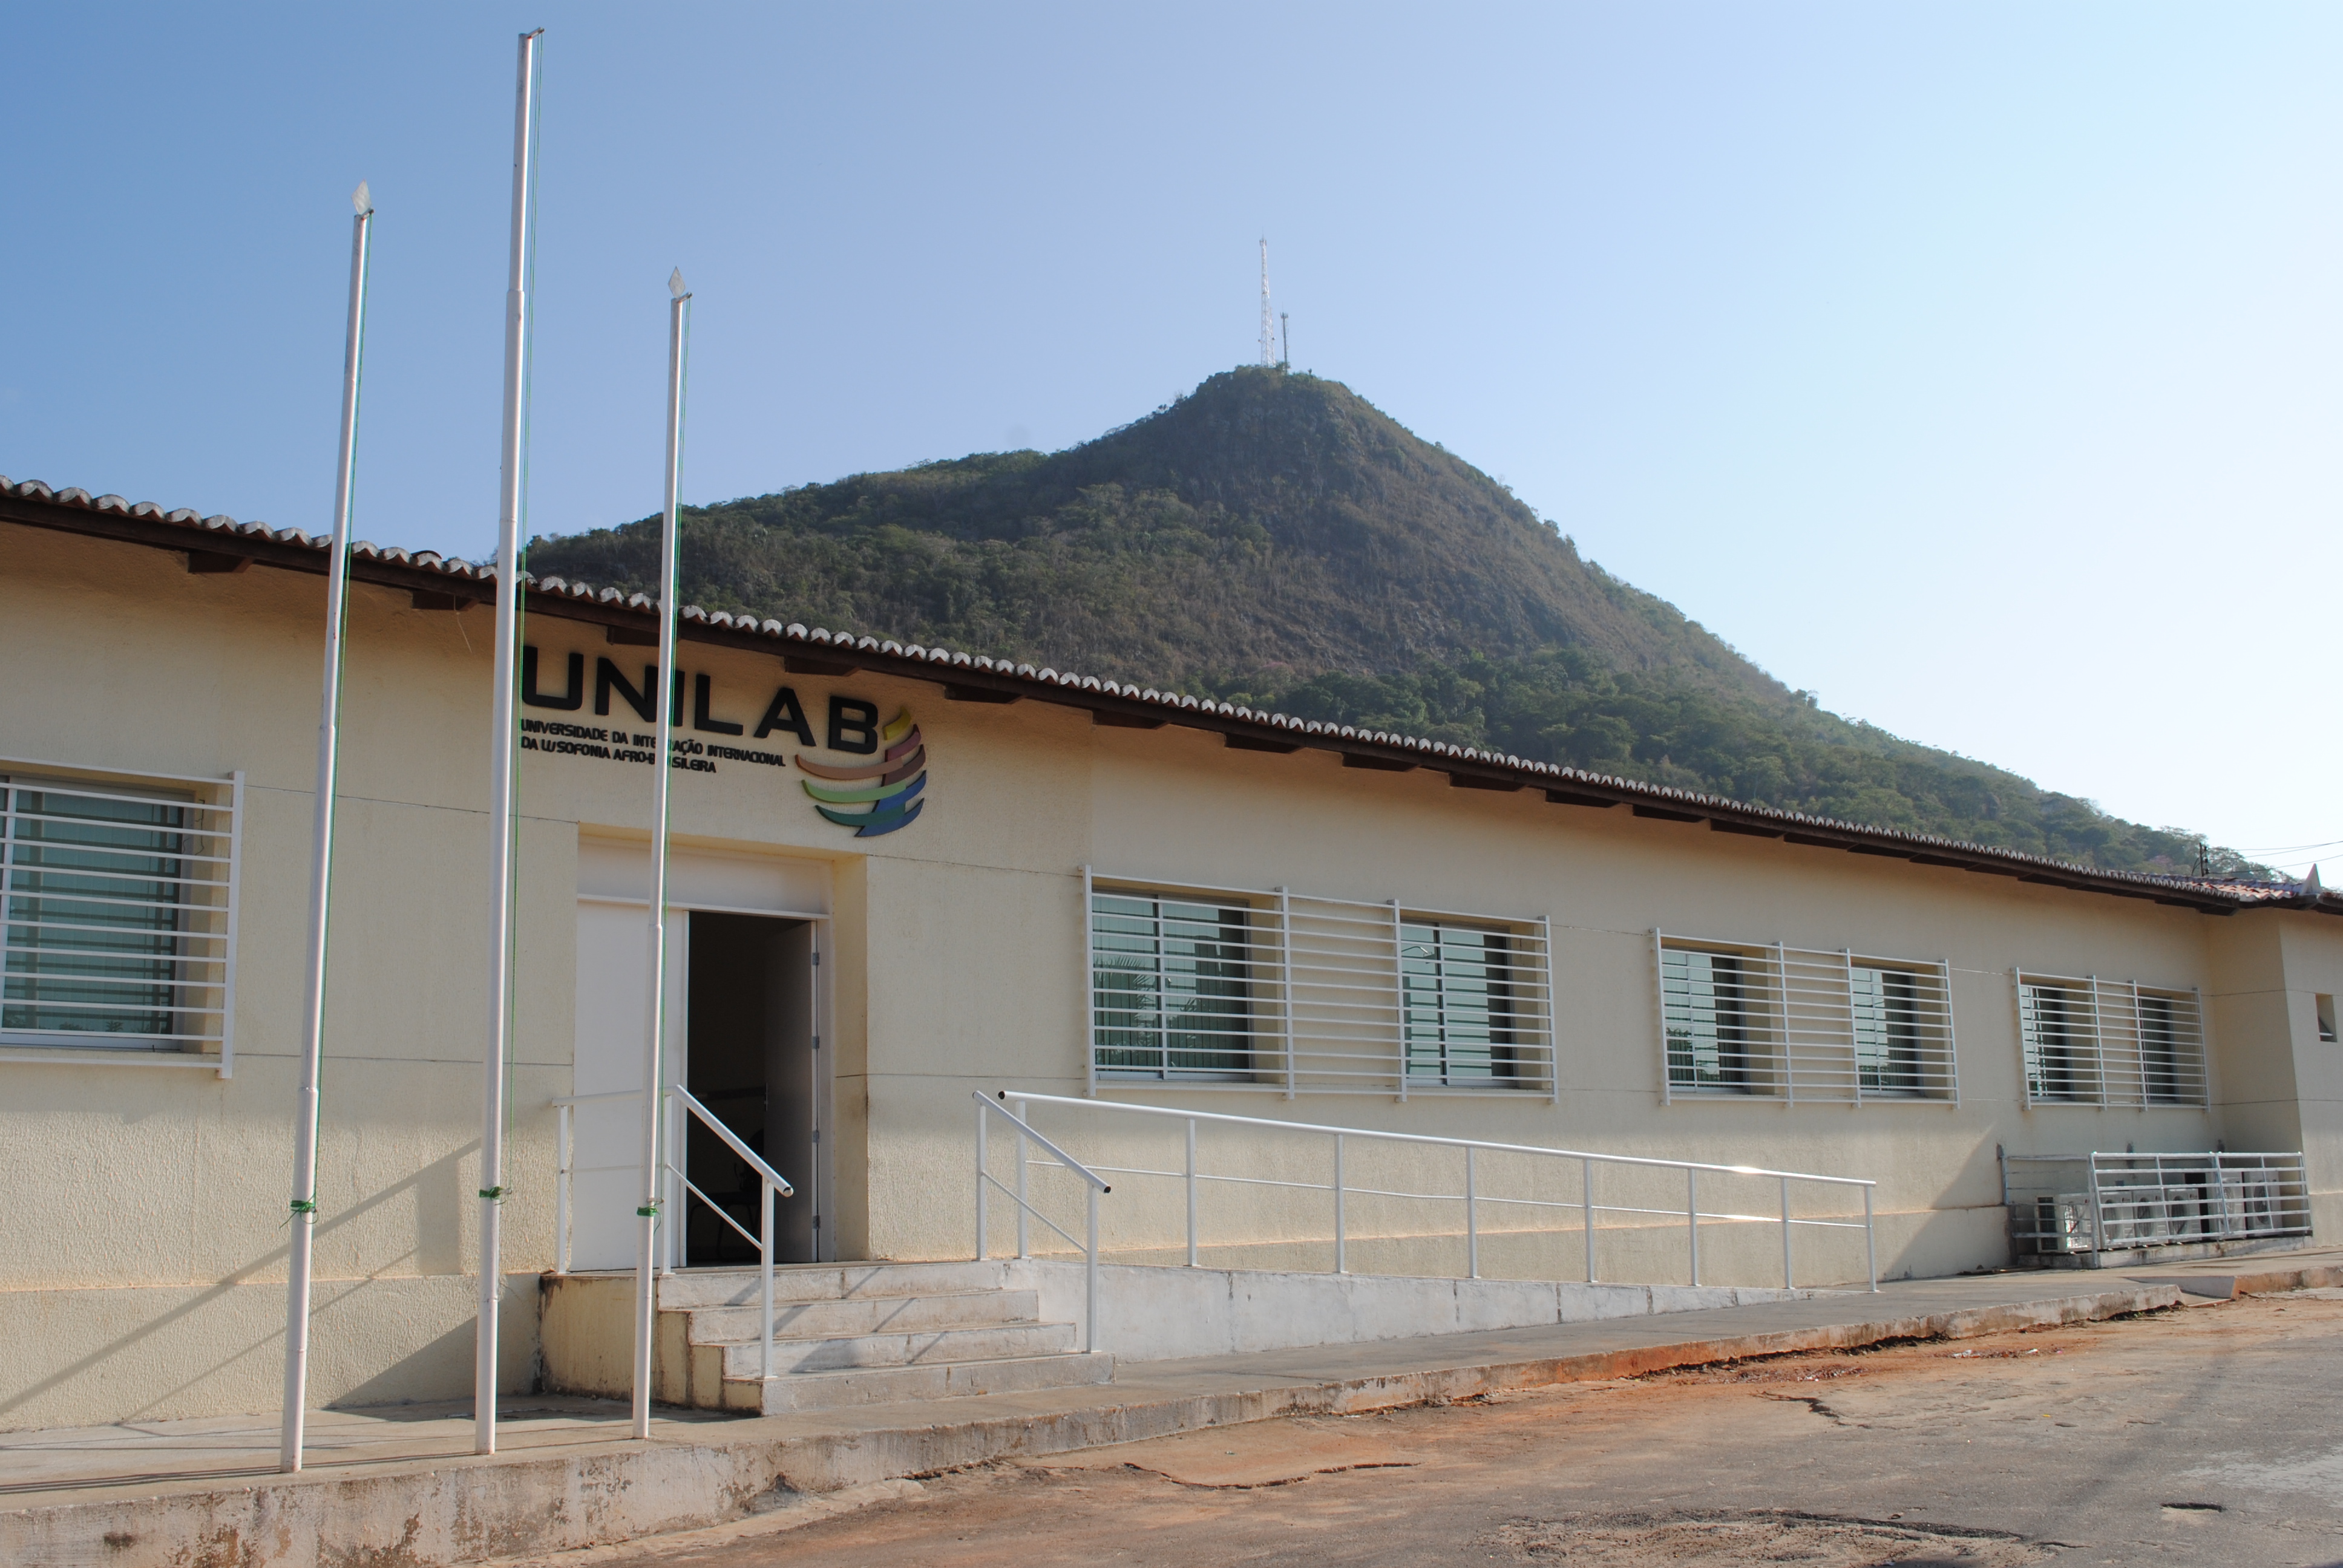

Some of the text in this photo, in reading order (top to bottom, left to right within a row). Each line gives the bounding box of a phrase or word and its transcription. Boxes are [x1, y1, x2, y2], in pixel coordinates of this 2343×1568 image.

[522, 645, 879, 755] UNILAB
[521, 719, 786, 767] UNIVERSIDADE DA INTEAÇÃO INTERNACIONAL
[521, 736, 716, 773] DA LUSOFONIA AFRO-BSILEIRA
